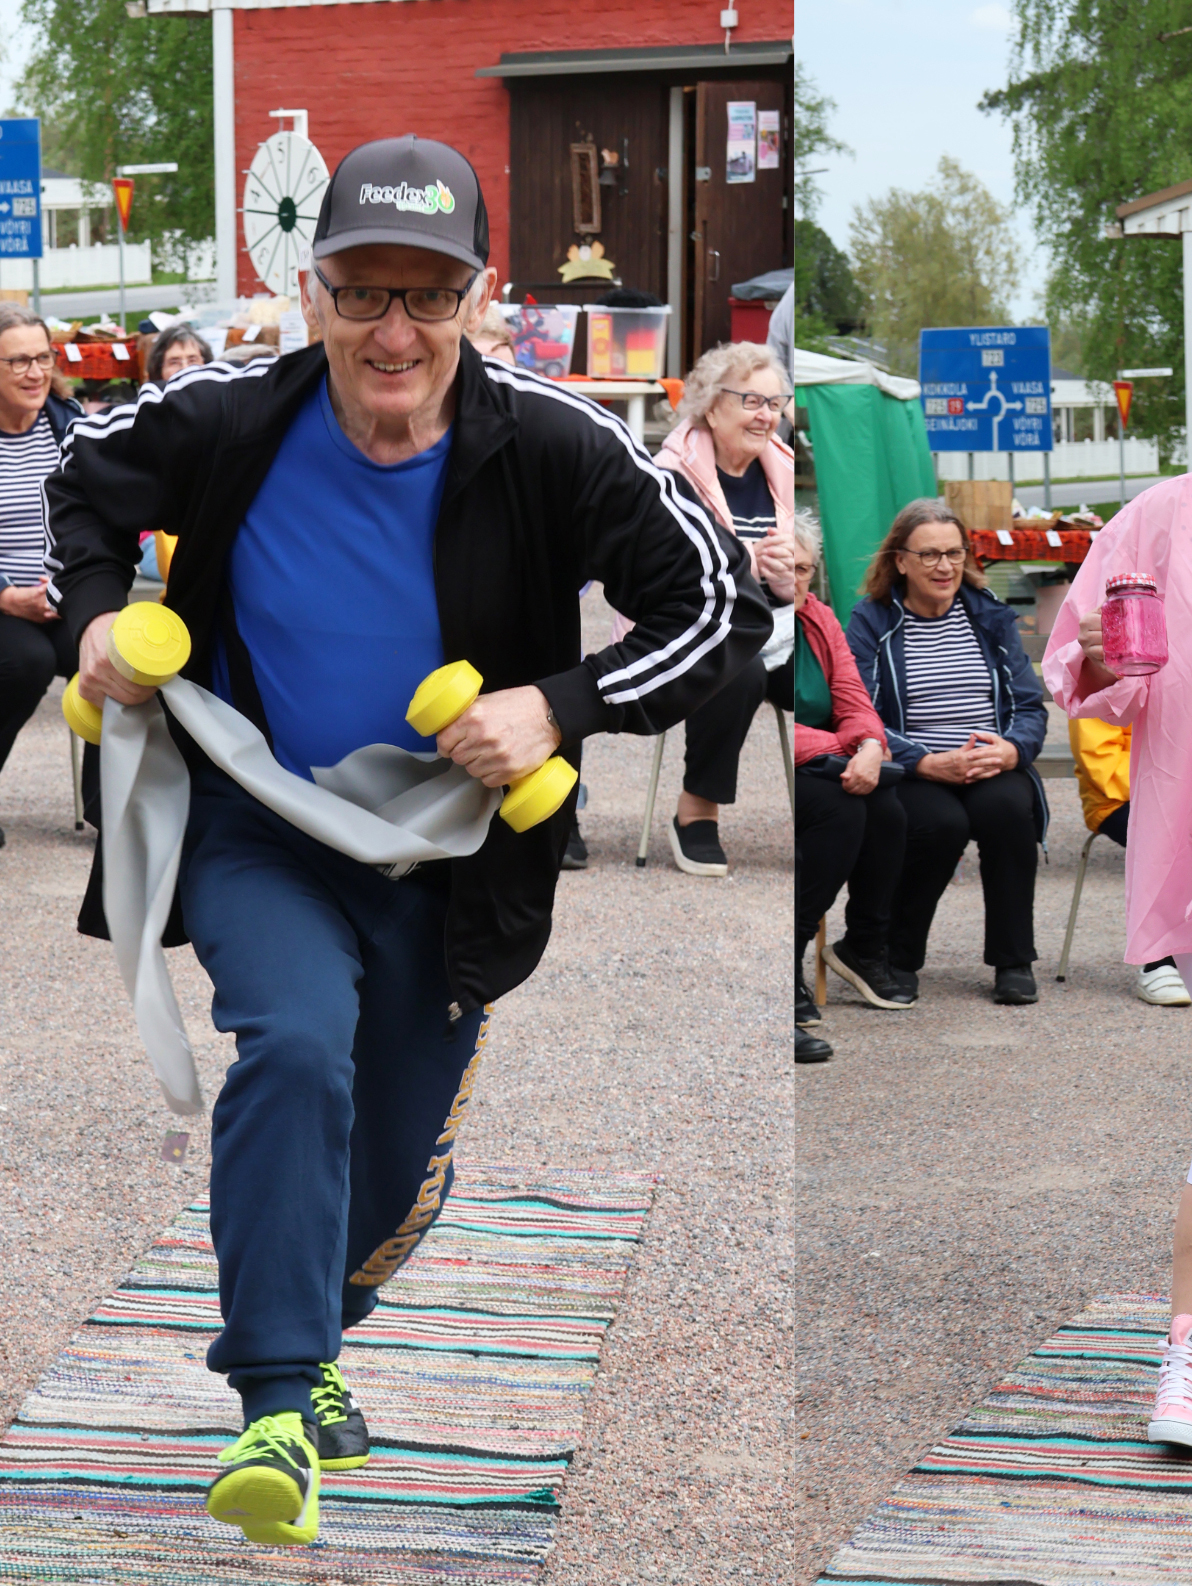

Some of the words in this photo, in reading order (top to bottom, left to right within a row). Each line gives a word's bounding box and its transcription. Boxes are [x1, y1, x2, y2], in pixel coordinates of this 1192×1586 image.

[969, 332, 1017, 346] YLISTARO
[923, 382, 968, 396] KOKKOLA
[1011, 381, 1045, 394] VAASA
[1012, 416, 1043, 431] VÖYRI
[1012, 431, 1041, 446] VÖRÄ
